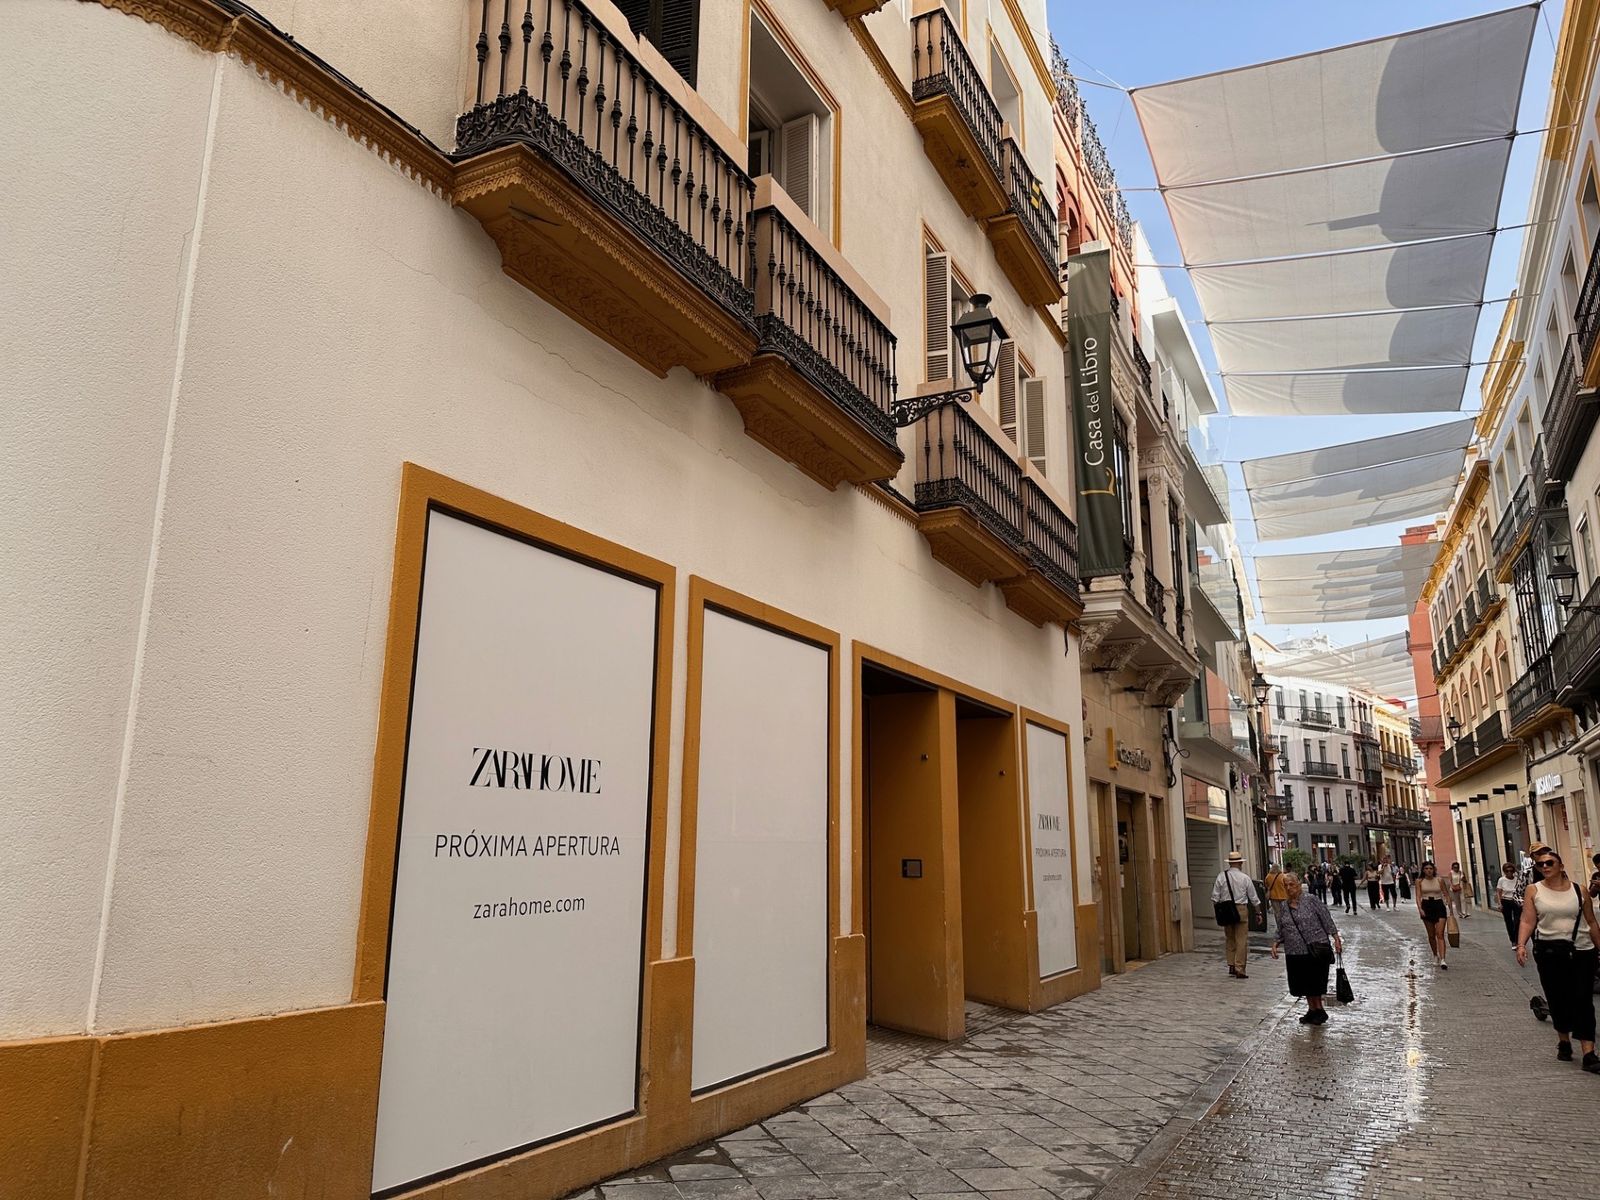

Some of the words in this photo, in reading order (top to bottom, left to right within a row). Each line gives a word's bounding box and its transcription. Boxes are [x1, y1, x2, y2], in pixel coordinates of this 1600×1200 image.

[1080, 337, 1099, 387] Libro
[1086, 390, 1100, 413] del
[1084, 417, 1105, 466] Casa
[435, 829, 527, 858] PRÓXIMA
[532, 835, 620, 857] APERTURA
[473, 896, 585, 919] zarahome.com
